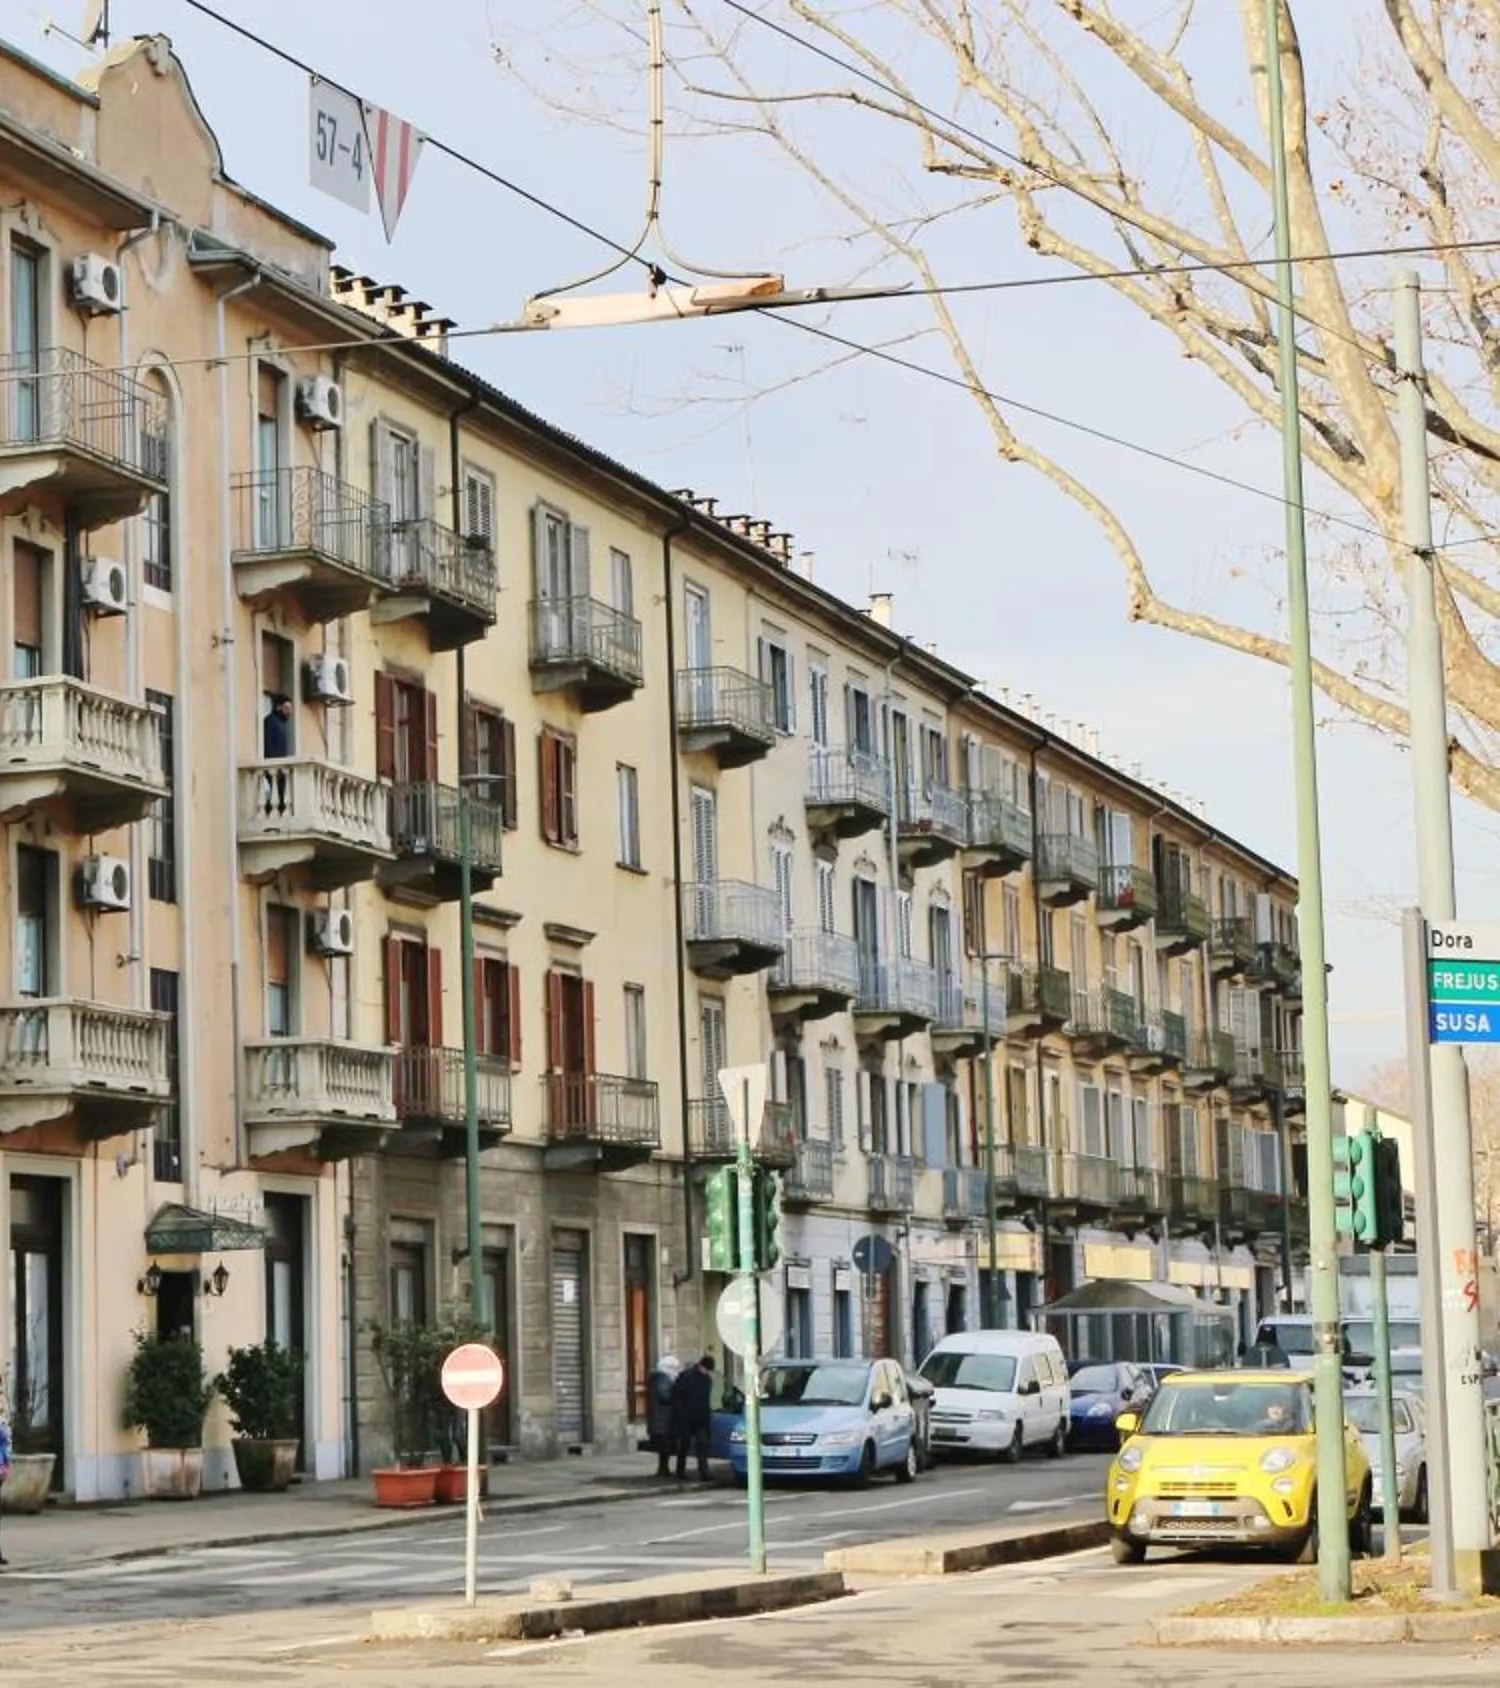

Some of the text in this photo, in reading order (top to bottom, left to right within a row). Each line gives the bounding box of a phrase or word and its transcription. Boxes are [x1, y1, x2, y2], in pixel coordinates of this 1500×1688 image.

[315, 110, 363, 182] 57-4
[1430, 929, 1474, 949] Dora
[1433, 971, 1499, 991] FREJUS
[1435, 1013, 1492, 1033] SUSA
